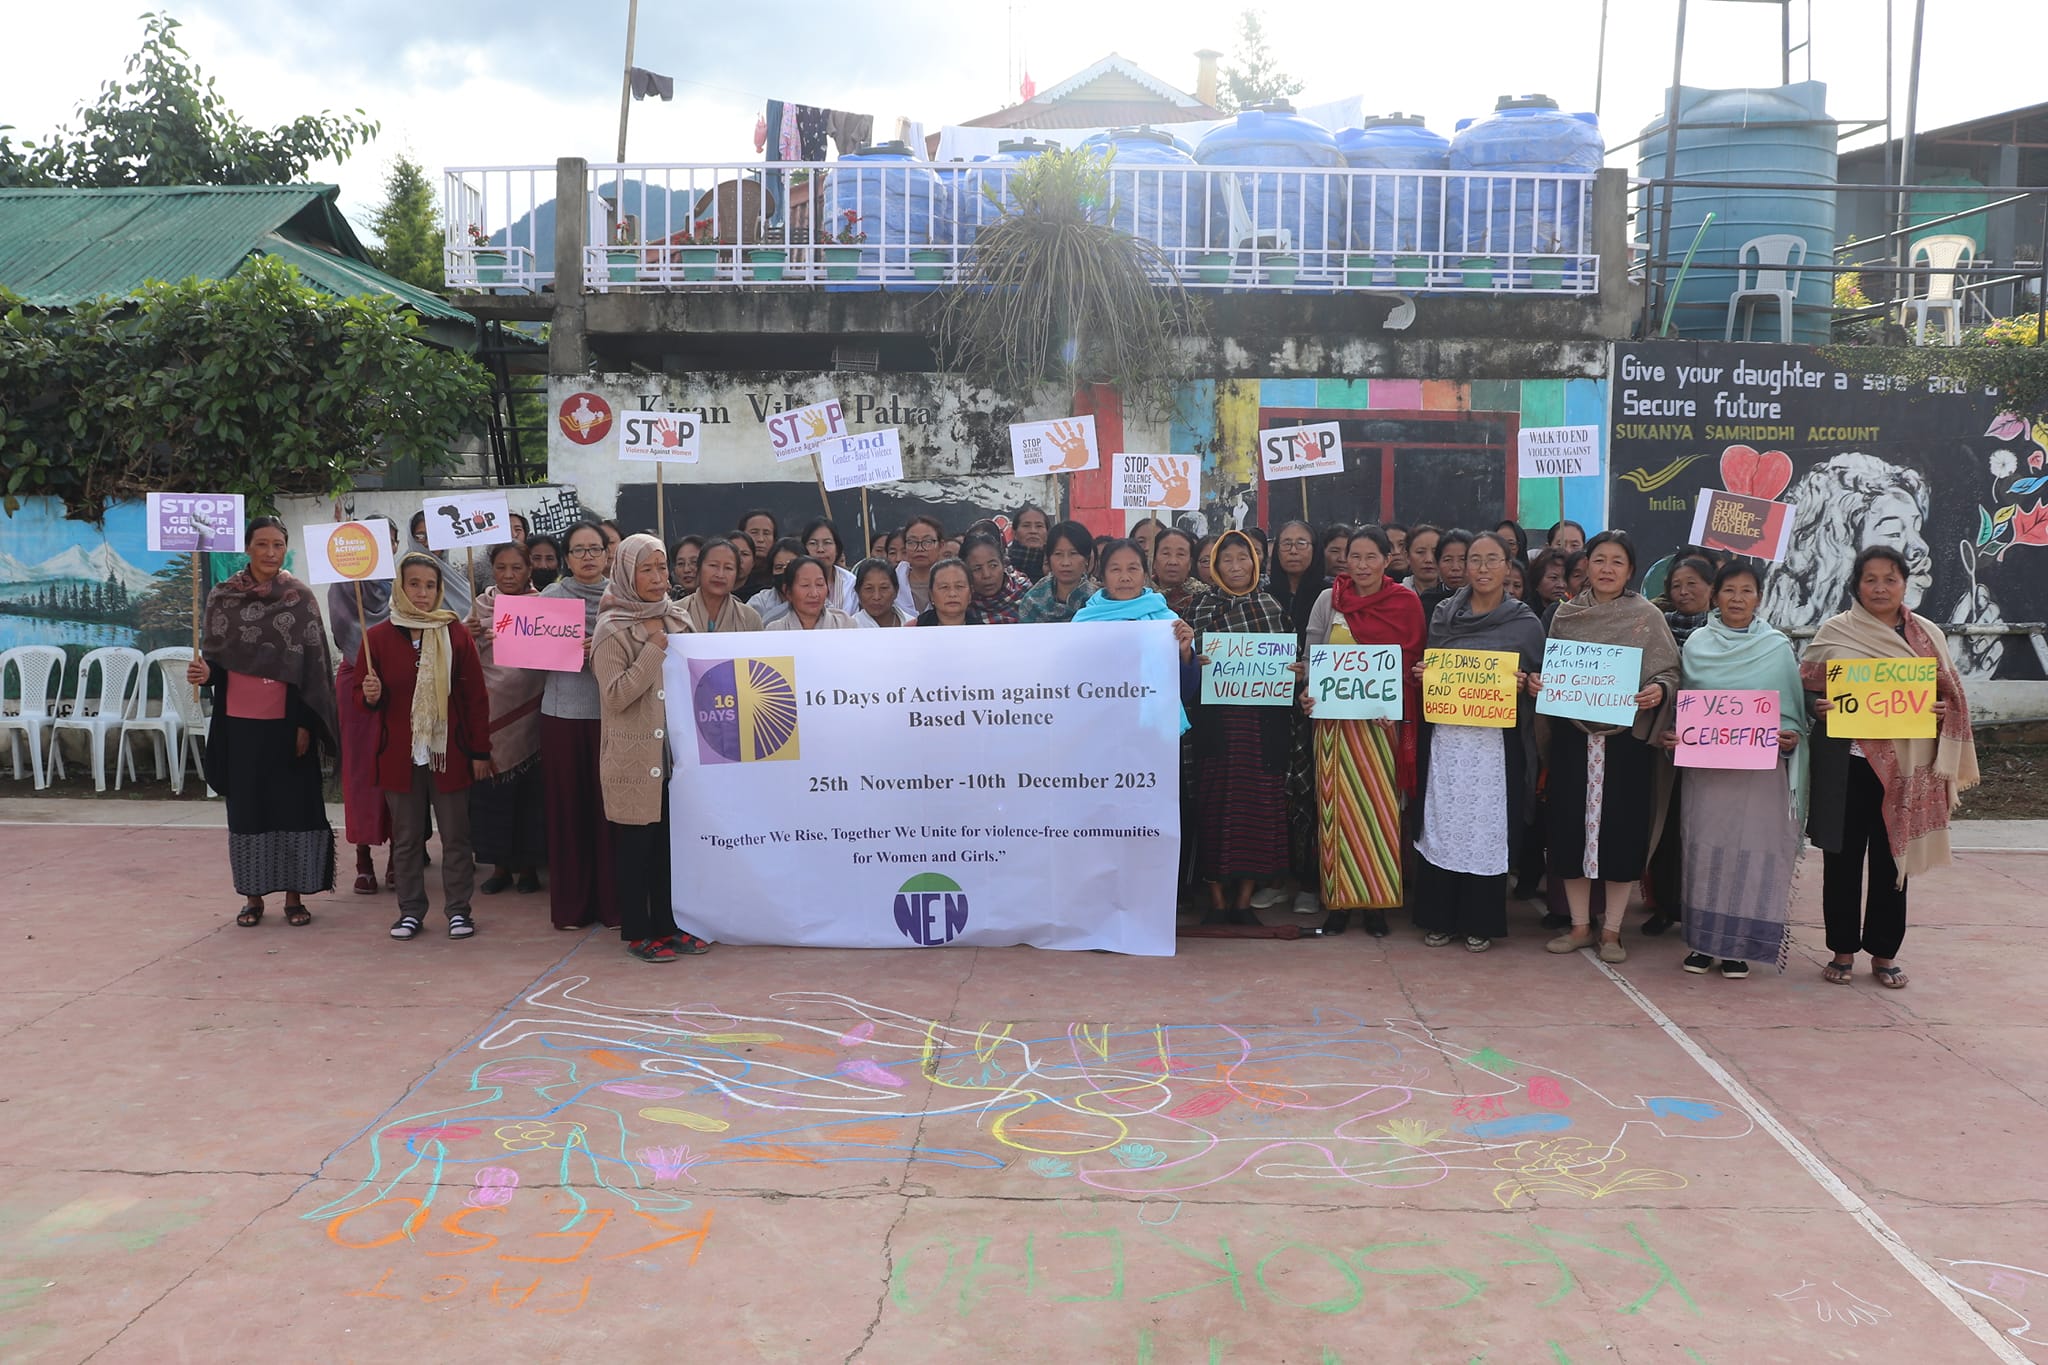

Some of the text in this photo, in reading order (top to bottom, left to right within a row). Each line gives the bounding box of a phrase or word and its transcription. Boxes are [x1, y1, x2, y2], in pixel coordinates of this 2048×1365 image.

[1621, 353, 1666, 382] Give
[1676, 365, 1724, 389] your
[1732, 358, 1826, 395] daughter
[1833, 371, 1849, 390] a
[853, 393, 935, 425] Patra
[1623, 388, 1782, 419] Secure future
[625, 418, 694, 448] STP
[768, 403, 842, 448] STP
[1615, 423, 1881, 442] SUKANYA SAMRIDDHI ACCOUNT
[842, 432, 884, 453] End
[1022, 438, 1042, 448] STOP
[1529, 429, 1588, 444] WALK TO END
[650, 447, 670, 456] Against
[1267, 431, 1335, 464] STP
[1528, 446, 1591, 457] VIOLENCE AGAINST
[1124, 456, 1149, 474] STOP
[1294, 462, 1315, 472] Against
[1535, 459, 1582, 474] WOMEN
[1123, 474, 1152, 484] VIOLENCE
[1123, 484, 1151, 495] AGAINST
[161, 499, 234, 514] STOP
[1123, 495, 1148, 508] WOMEN
[1648, 495, 1686, 511] India
[1716, 499, 1744, 510] STOP
[1713, 516, 1749, 528] BASED
[1714, 508, 1762, 522] GENDER-
[162, 526, 235, 535] VIOLCE
[1711, 522, 1760, 538] VIOLENCE
[333, 536, 345, 546] 16
[1228, 635, 1254, 657] WE
[1258, 642, 1296, 657] STAND
[1576, 645, 1602, 656] DAYS
[1606, 648, 1624, 657] OF
[1333, 650, 1369, 672] YES
[1372, 649, 1395, 672] TO
[1455, 654, 1481, 669] DAYS
[1484, 657, 1499, 671] OF
[1212, 661, 1289, 678] AGAINST
[1846, 664, 1872, 683] NO
[1874, 662, 1937, 683] EXCUSE
[1542, 673, 1567, 684] END
[804, 680, 1157, 709] 16 Days of Activism against Gender-
[1214, 681, 1293, 698] VIOLENCE
[1319, 677, 1397, 702] PEACE
[1427, 684, 1452, 697] END
[1546, 688, 1639, 707] BASED VIOLENC
[714, 694, 735, 709] 16
[1703, 695, 1743, 717] YES
[1753, 696, 1772, 714] TO
[1833, 689, 1929, 718] TO GBV
[699, 709, 735, 723] DAYS
[908, 709, 1054, 727] Based Violence
[1425, 701, 1518, 720] BASED VIOLENCE
[1681, 726, 1778, 748] CEASEFIRE
[808, 777, 848, 793] 25th
[860, 774, 954, 792] November
[1017, 772, 1110, 789] December
[1113, 771, 1157, 789] 2023
[769, 830, 791, 843] We
[795, 828, 828, 842] Rise,
[831, 825, 891, 842] Together
[894, 826, 917, 838] We
[920, 824, 958, 838] Unite
[961, 824, 981, 838] for
[984, 824, 1069, 838] violence-free
[1072, 825, 1161, 838] communities
[852, 849, 1007, 865] for Women and Girls.”
[893, 892, 970, 946] NEN
[325, 1197, 715, 1264] KESO
[340, 1266, 592, 1316] FACT
